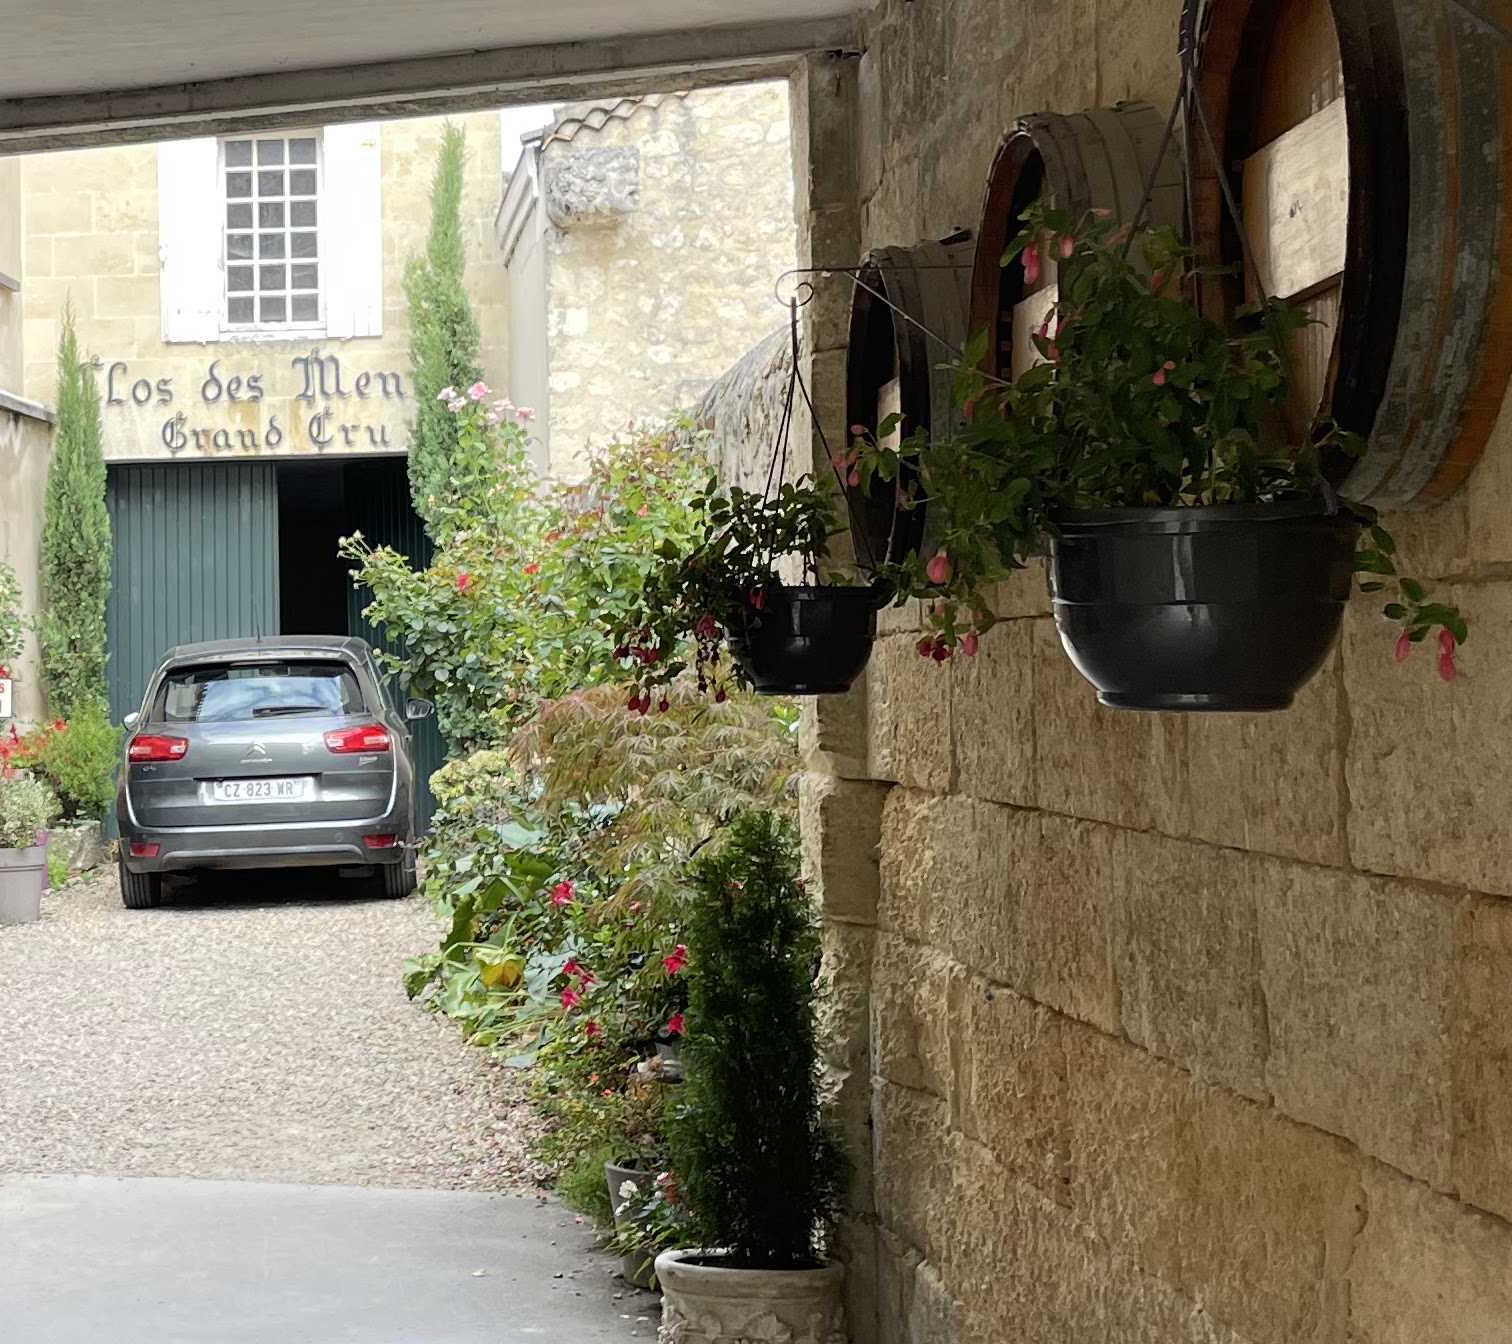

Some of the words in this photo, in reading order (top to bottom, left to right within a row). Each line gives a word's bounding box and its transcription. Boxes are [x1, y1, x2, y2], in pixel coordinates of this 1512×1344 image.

[201, 358, 266, 405] des
[161, 411, 284, 459] Grand
[308, 405, 391, 456] Cru
